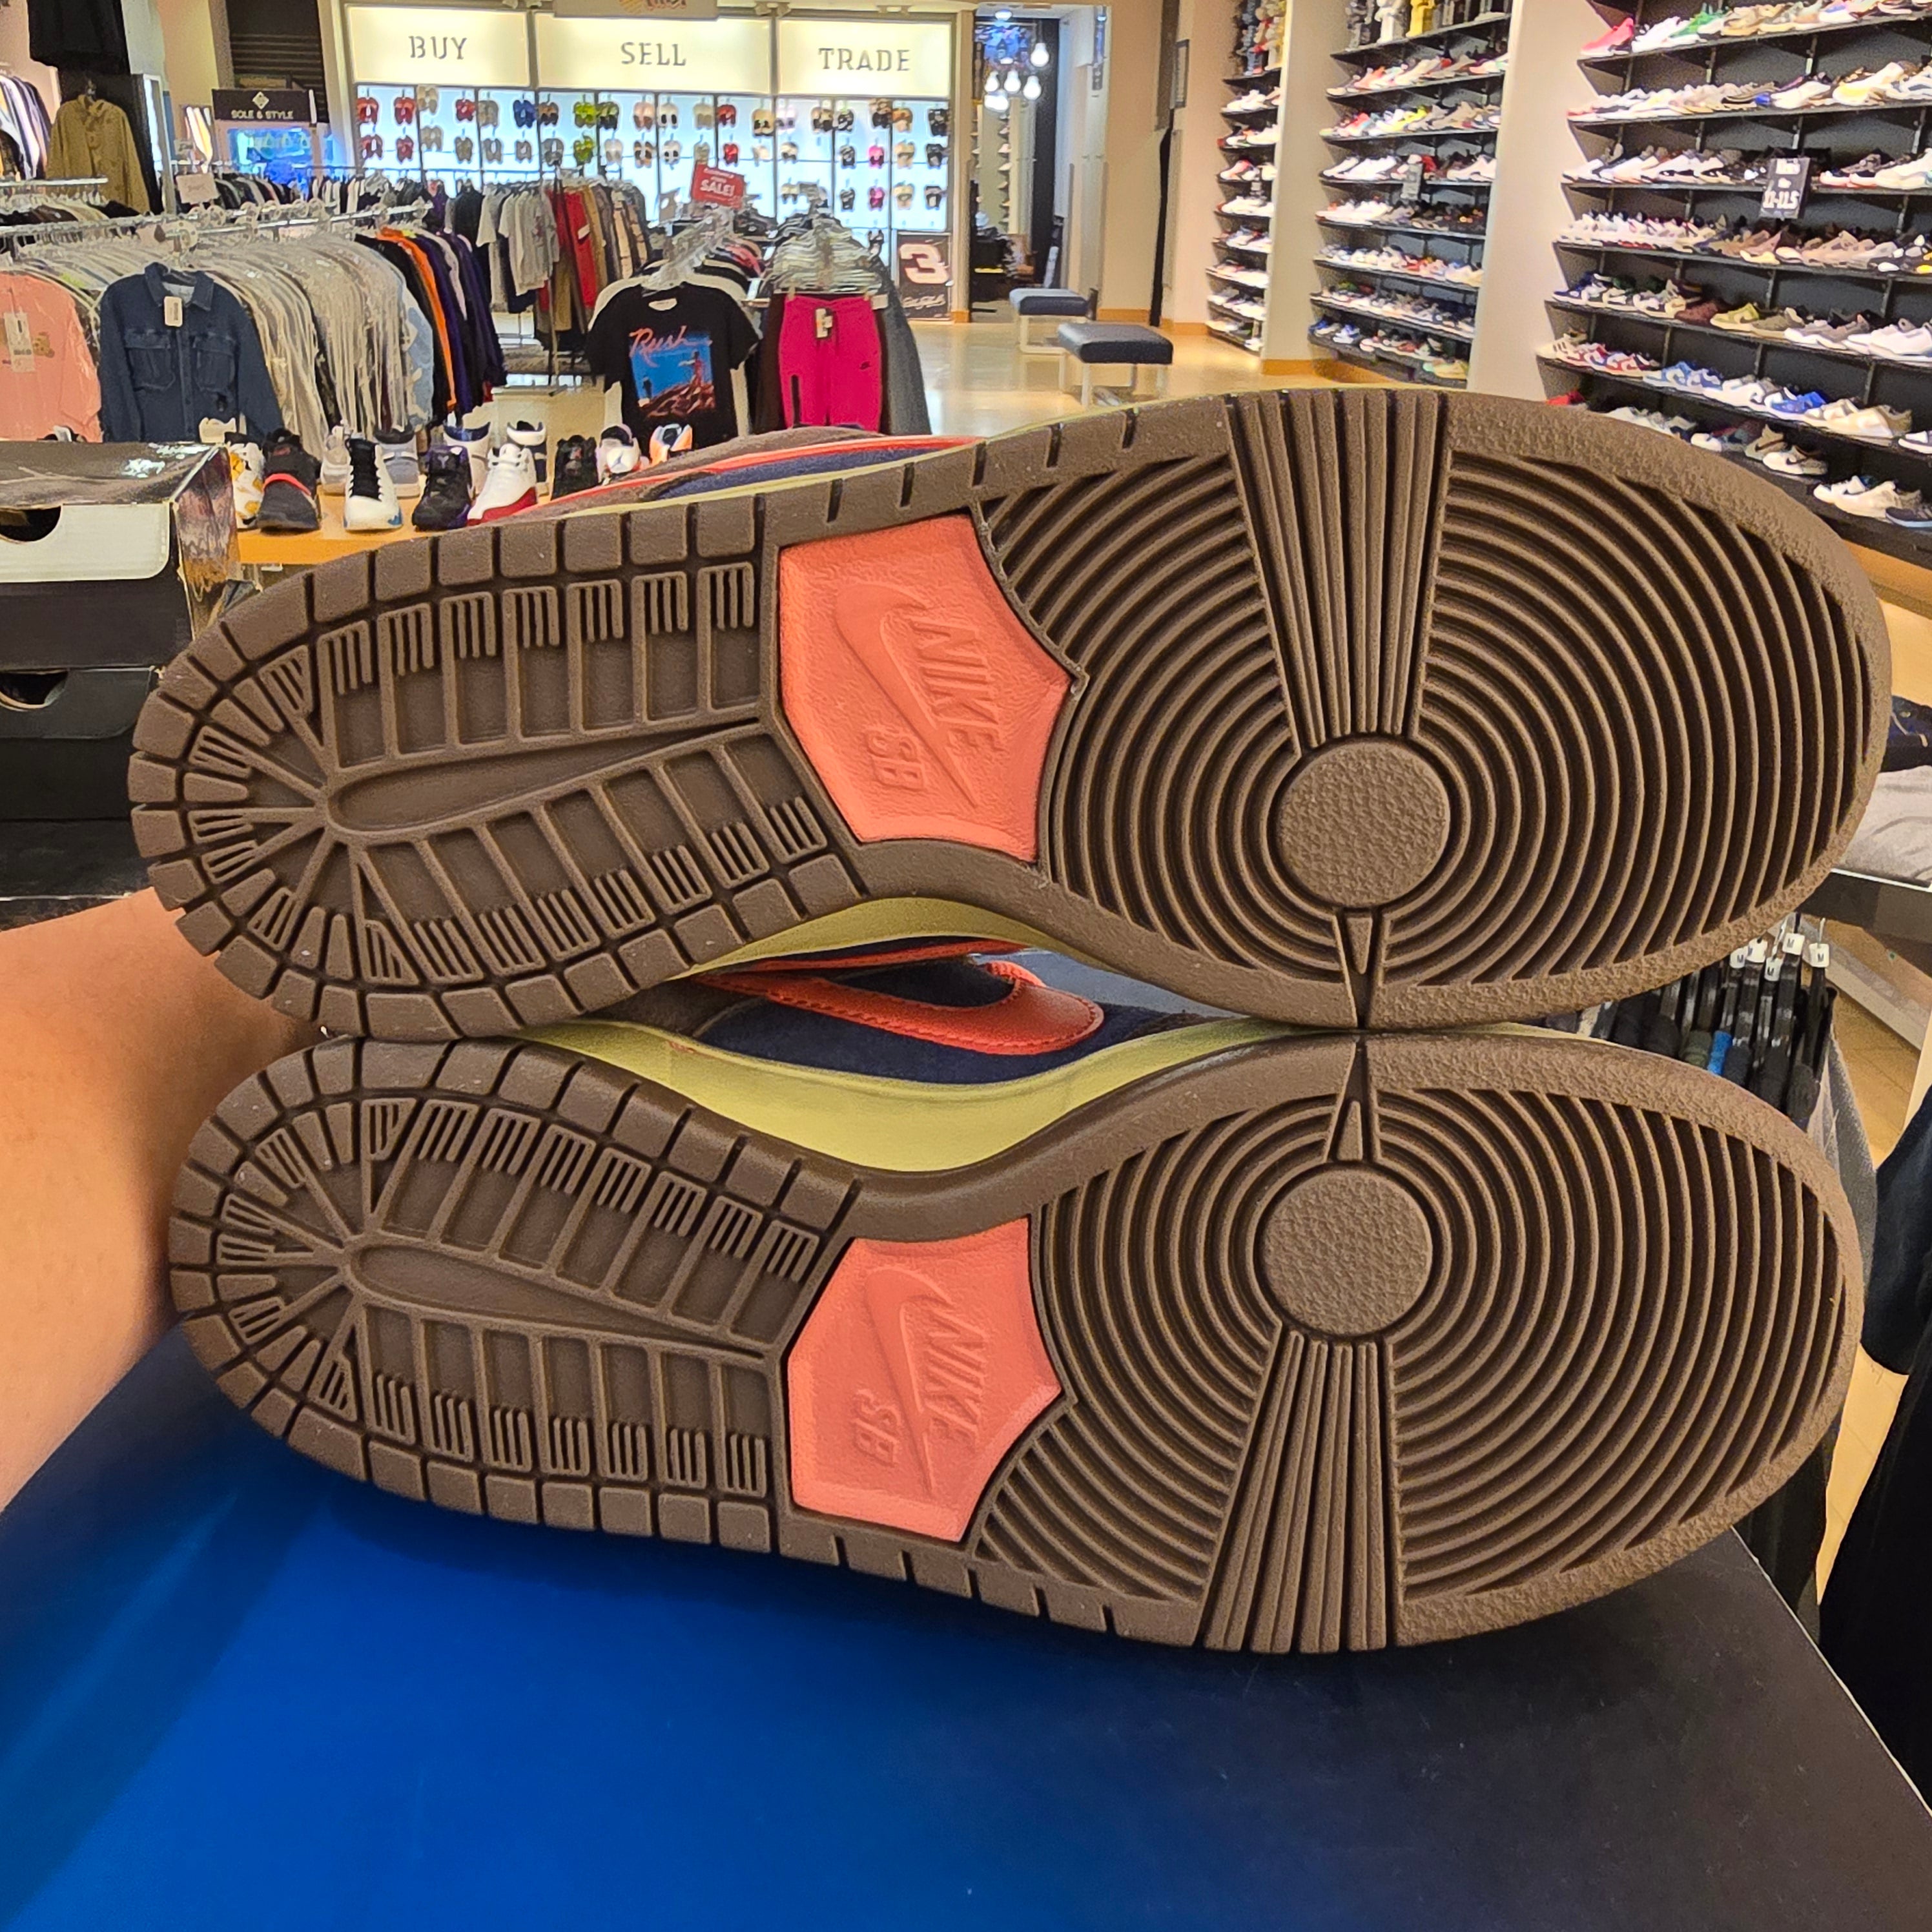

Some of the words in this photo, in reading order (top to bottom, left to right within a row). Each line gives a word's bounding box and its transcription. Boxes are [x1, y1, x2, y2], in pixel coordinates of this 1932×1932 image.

[408, 36, 468, 59] BUY
[620, 42, 687, 67] SELL
[817, 47, 911, 72] TRADE
[231, 109, 254, 119] SOLE
[265, 110, 294, 120] STYLE
[899, 243, 949, 284] 3
[628, 325, 713, 368] Rush
[905, 614, 1006, 758] NIKE
[864, 724, 926, 792] SB
[925, 1307, 989, 1448] NIKE
[853, 1387, 902, 1468] SB
